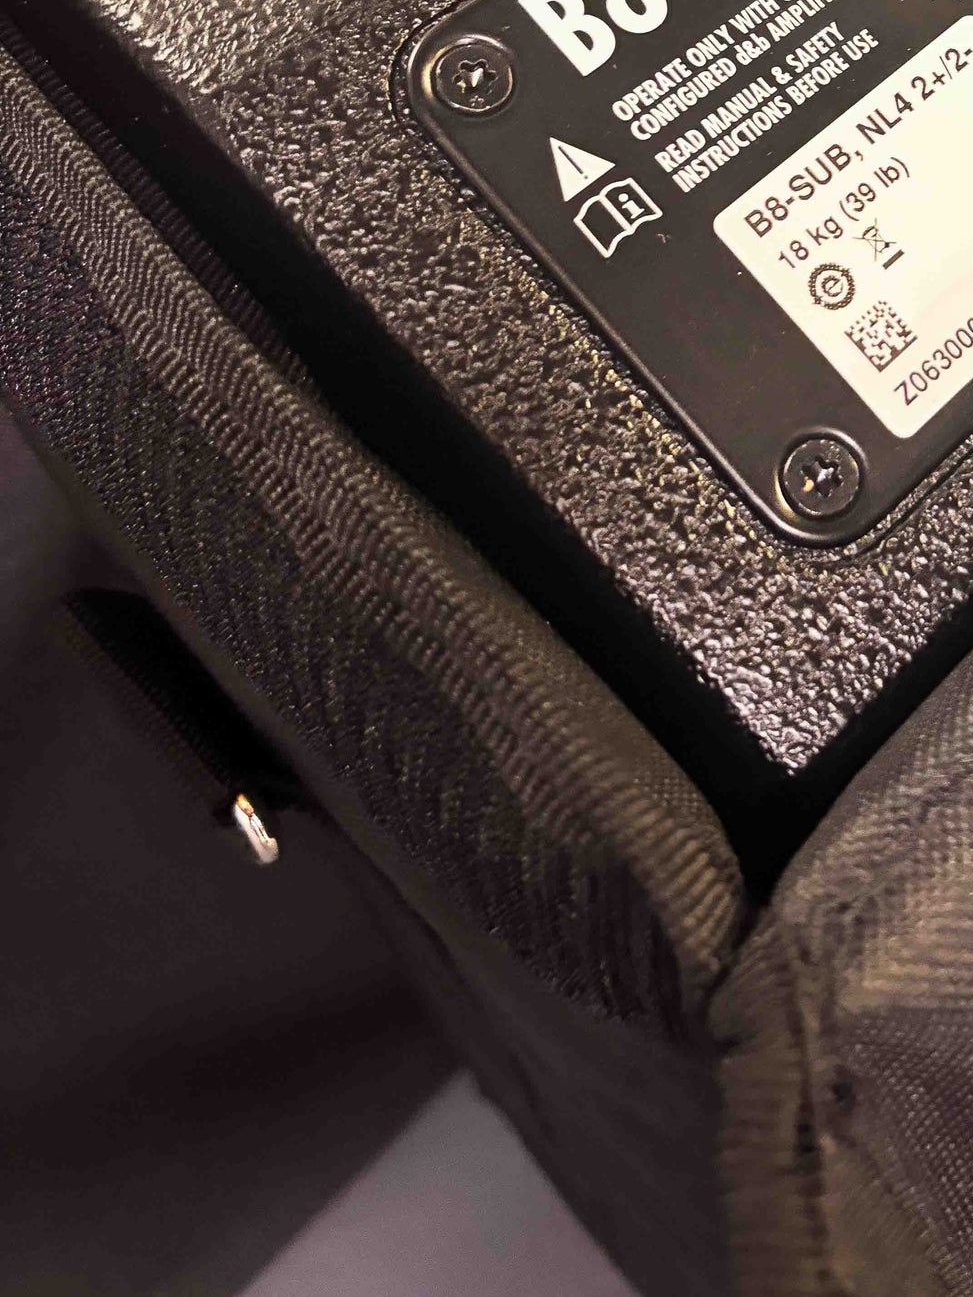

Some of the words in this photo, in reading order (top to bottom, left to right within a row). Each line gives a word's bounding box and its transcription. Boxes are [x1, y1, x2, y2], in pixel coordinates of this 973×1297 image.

[612, 57, 693, 121] OPERATE
[685, 24, 736, 68] ONLY
[630, 57, 737, 141] CONFIGURED
[733, 32, 772, 66] d&b
[654, 129, 706, 173] READ
[700, 76, 778, 139] MANUAL
[770, 66, 794, 85] &
[785, 21, 845, 74] SAFETY
[671, 95, 793, 193] INSTRUCTIONS
[785, 51, 850, 106] BEFORE
[841, 28, 879, 61] USE
[744, 143, 863, 238] B8-SUB,
[855, 92, 914, 145] NL4
[910, 48, 973, 101] 2+/2-
[778, 240, 809, 269] 18
[806, 216, 844, 246] kg
[839, 182, 876, 222] (39
[873, 156, 910, 188] lb)
